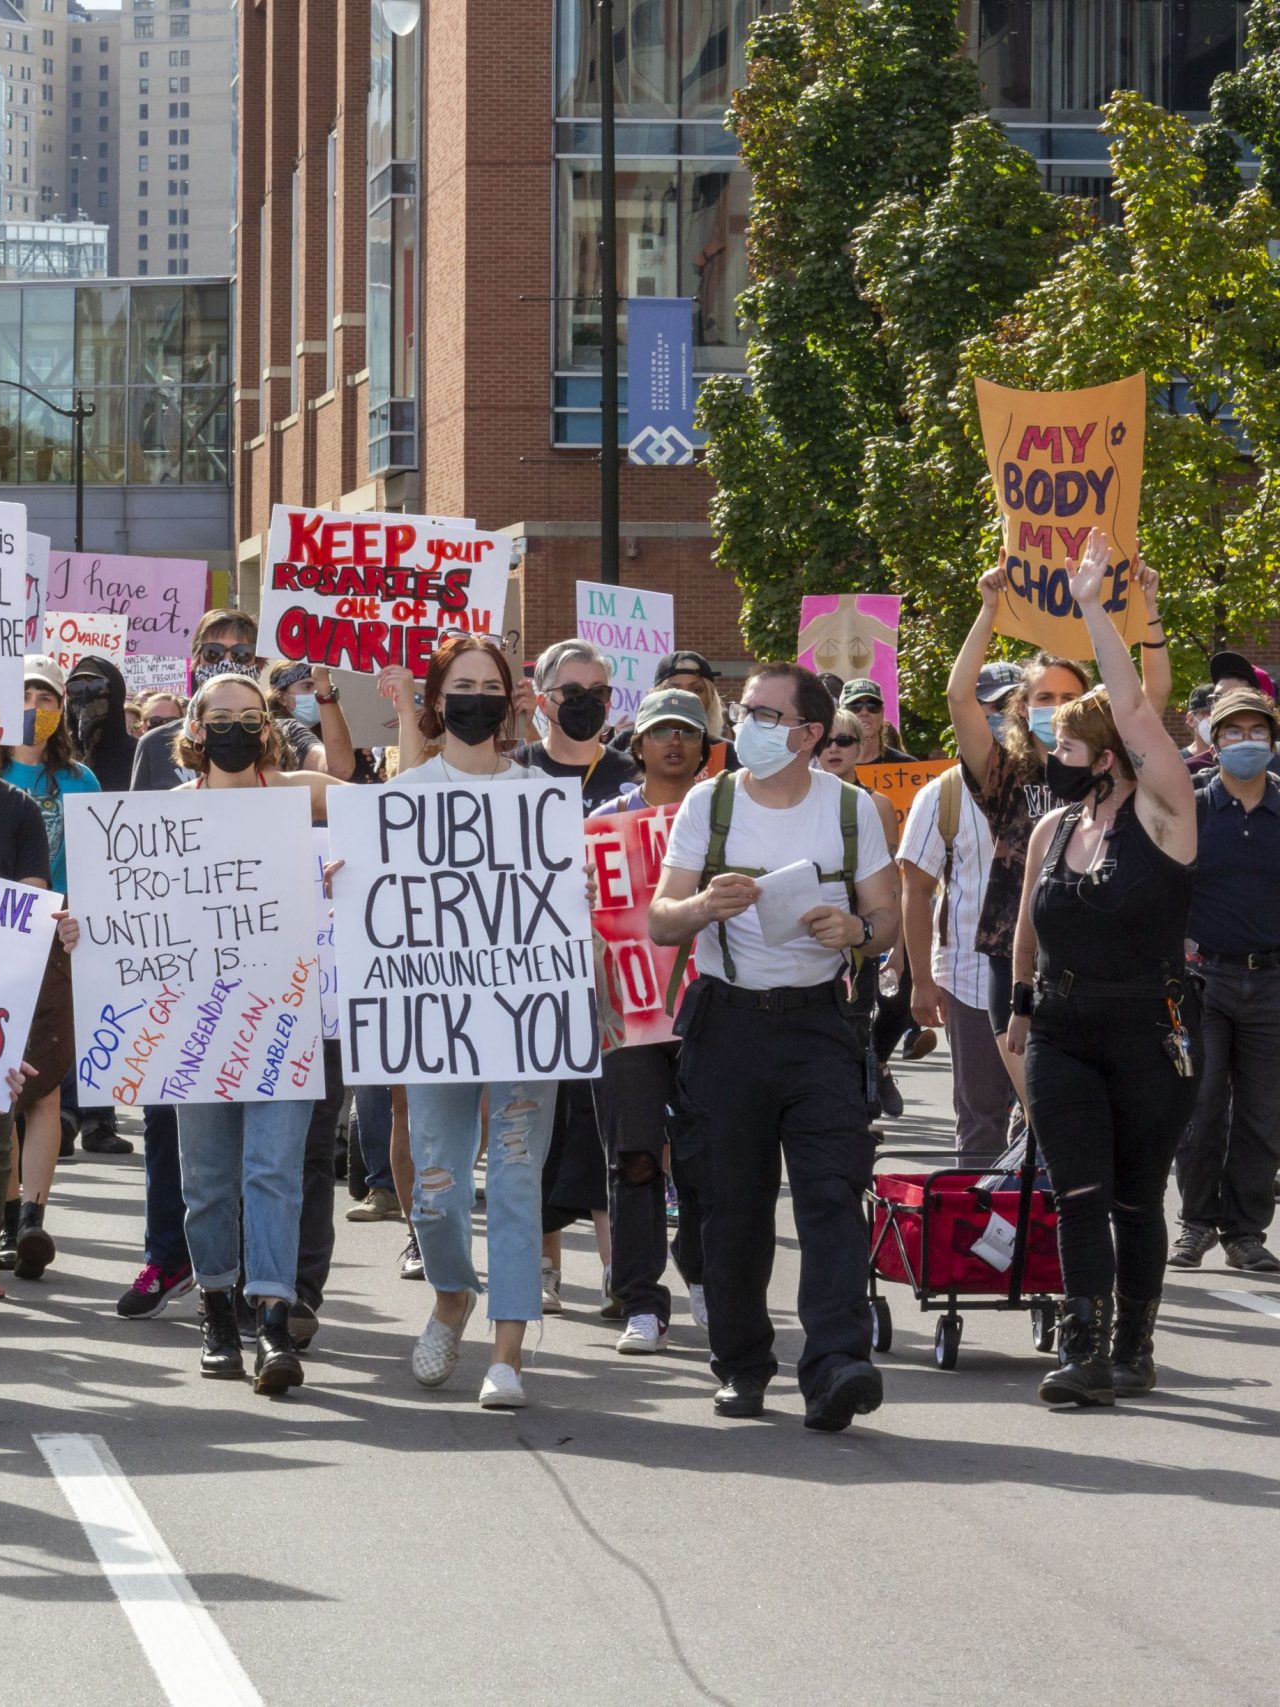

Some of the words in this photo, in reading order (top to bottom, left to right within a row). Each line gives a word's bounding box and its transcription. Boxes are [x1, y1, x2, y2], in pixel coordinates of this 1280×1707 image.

[1017, 421, 1098, 464] MY
[1003, 461, 1114, 517] BODY
[286, 512, 417, 568] KEEP
[416, 538, 495, 573] your
[84, 559, 149, 601] have
[163, 587, 180, 604] a
[271, 562, 473, 613] ROSARIES
[587, 590, 617, 617] IM
[630, 594, 648, 621] A
[1006, 555, 1131, 619] CHOCE
[335, 597, 381, 621] out
[391, 598, 426, 625] of
[579, 620, 671, 656] WOMAN
[276, 605, 451, 679] OVARIE
[378, 788, 573, 872] PUBLIC
[109, 859, 262, 900] PRO-LIFE
[86, 910, 191, 948] UNTIL
[202, 900, 279, 940] THE
[364, 869, 571, 949] CERVIX
[115, 948, 198, 987] BABY
[363, 938, 593, 990] ANNOUNCEMENT
[160, 977, 243, 1100] TRANSGENDER,
[214, 991, 276, 1102] MEXICAN,
[256, 1012, 298, 1097] DISABLED,
[281, 954, 318, 1009] SICK,
[348, 991, 480, 1076] FUCK
[493, 987, 600, 1074] YOU
[112, 1027, 166, 1106] BLACK,
